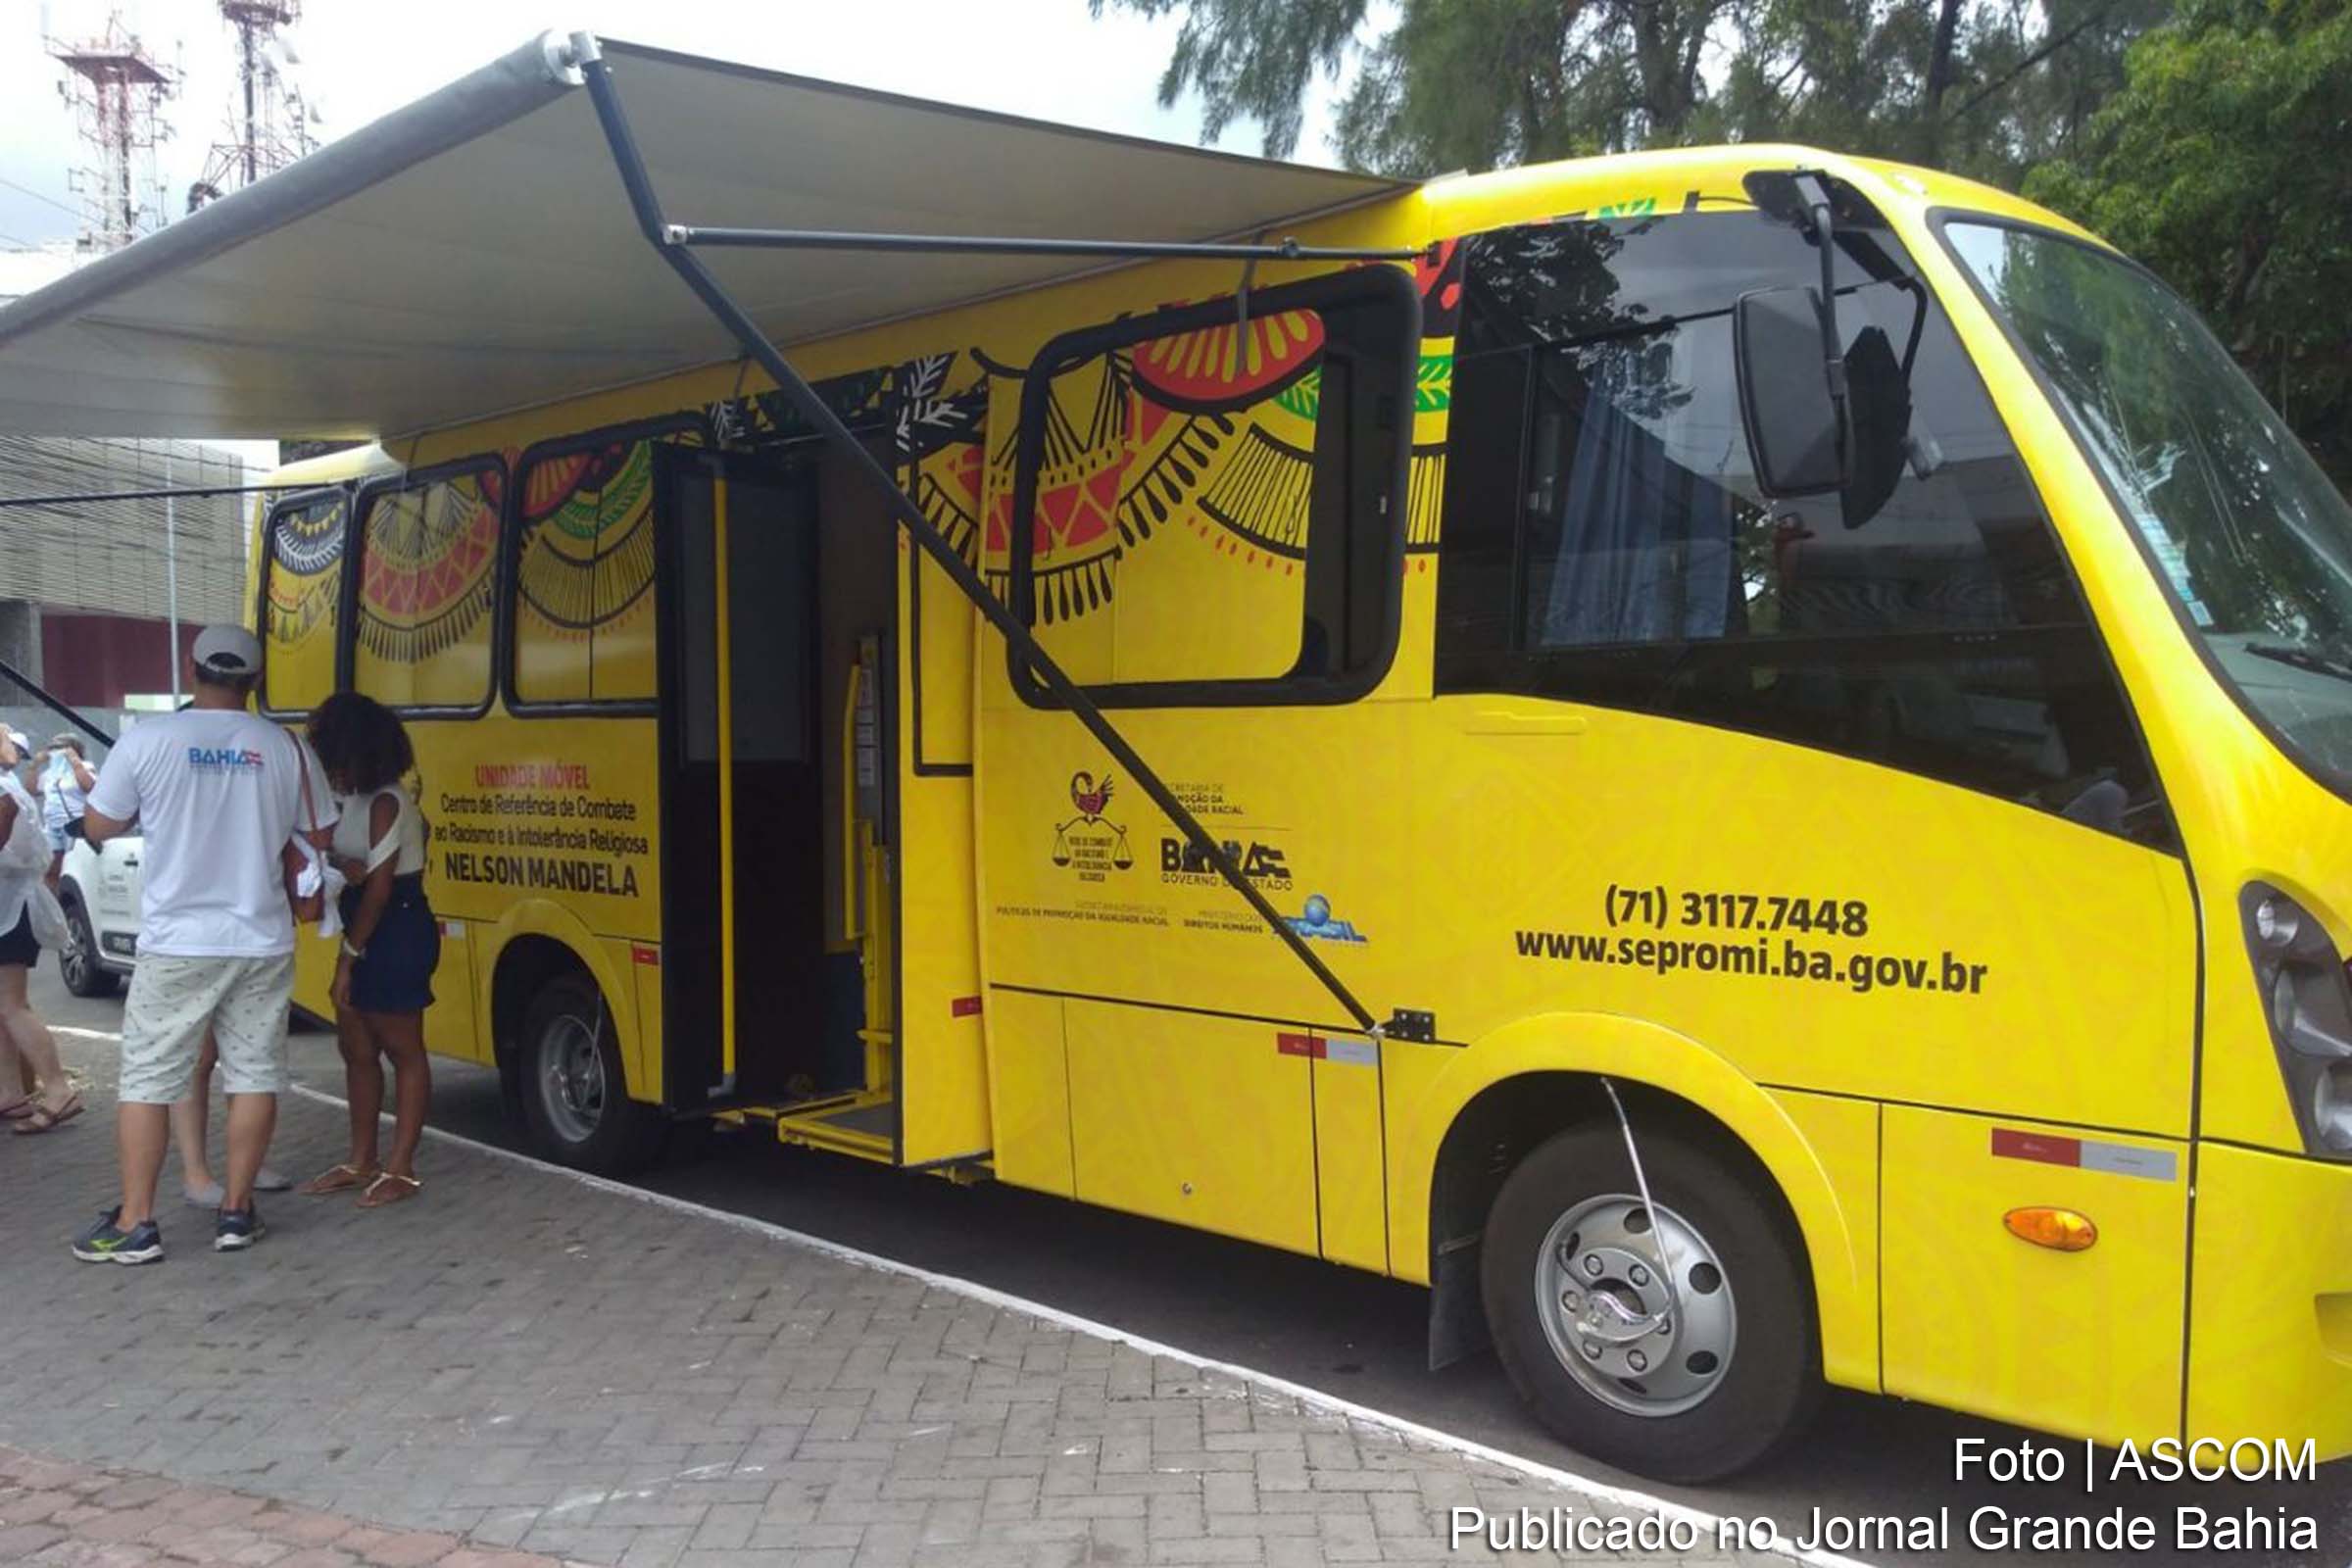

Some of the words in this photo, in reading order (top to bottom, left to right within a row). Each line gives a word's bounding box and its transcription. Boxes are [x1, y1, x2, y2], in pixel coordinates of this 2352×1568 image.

[188, 748, 249, 764] BAHIA
[475, 764, 536, 787] UNIDADE
[540, 759, 590, 790] MÓVEL
[441, 793, 477, 813] Centro
[479, 793, 493, 814] de
[496, 793, 557, 817] Referência
[560, 796, 574, 817] de
[576, 796, 637, 821] Combate
[435, 825, 447, 842] ao
[450, 822, 495, 844] Racismo
[498, 830, 506, 845] e
[516, 824, 587, 850] Intolerância
[590, 828, 649, 858] Religiosa
[445, 852, 525, 886] NELSON
[527, 857, 640, 898] MANDELA
[1161, 872, 1218, 888] GOVERNO
[1252, 878, 1295, 892] STADO
[1605, 884, 1668, 930] (71)
[1681, 891, 1869, 938] 3117.7448
[1515, 930, 1988, 995] www.sepromi.ba.gov.br
